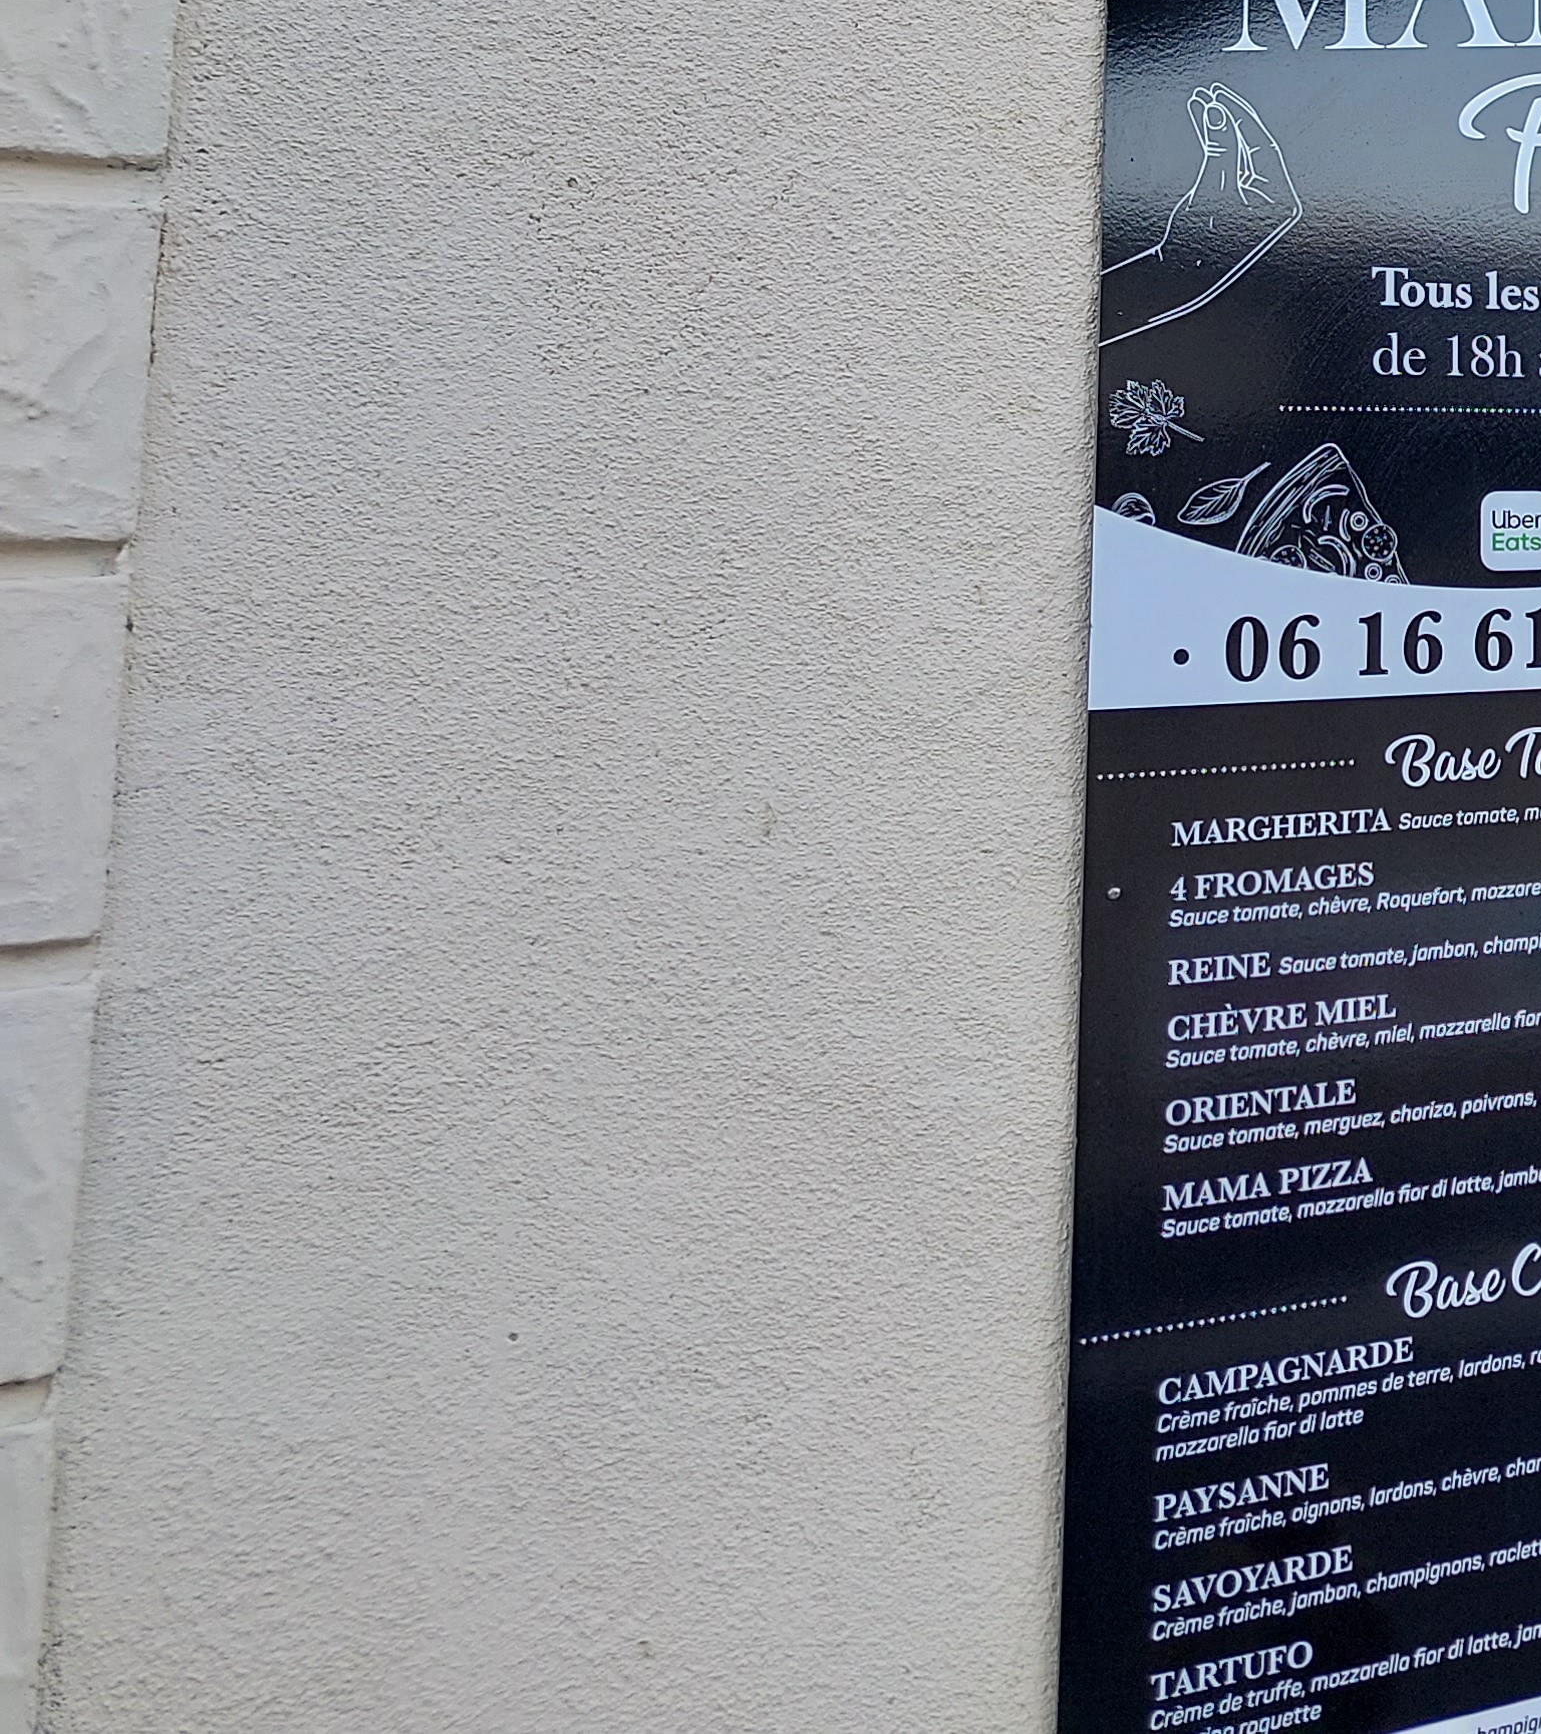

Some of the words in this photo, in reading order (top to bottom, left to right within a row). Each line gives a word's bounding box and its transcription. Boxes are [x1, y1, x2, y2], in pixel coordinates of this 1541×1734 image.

[1371, 266, 1473, 312] Tous
[1485, 270, 1541, 314] les
[1372, 333, 1427, 378] de
[1446, 335, 1522, 379] 18h
[1224, 613, 1322, 682] 06
[1357, 609, 1444, 677] 16
[1385, 733, 1501, 788] Base
[1171, 808, 1392, 847] MARGHERITA
[1398, 813, 1454, 830] Sauce
[1456, 807, 1520, 826] tomate,
[1169, 909, 1230, 928] Sauce
[1233, 902, 1303, 923] tomate,
[1377, 887, 1467, 912] Roquefort,
[1170, 877, 1188, 902] 4
[1194, 862, 1375, 900] FROMAGES
[1168, 952, 1272, 986] REINE
[1278, 956, 1337, 975] Sauce
[1340, 948, 1408, 969] tomate,
[1408, 940, 1479, 967] jambon,
[1165, 1049, 1226, 1069] Sauce
[1230, 1039, 1301, 1062] tomate,
[1305, 1032, 1370, 1053] chèvre,
[1375, 1023, 1415, 1046] miel,
[1419, 1012, 1512, 1040] mozzarella
[1168, 1003, 1308, 1042] CHÈVRE
[1315, 994, 1397, 1027] MIEL
[1163, 1132, 1225, 1154] Sauce
[1228, 1122, 1300, 1146] tomate,
[1304, 1112, 1386, 1136] merguez,
[1390, 1100, 1457, 1125] chorizo,
[1460, 1092, 1538, 1120] poivrons,
[1166, 1079, 1357, 1126] ORIENTALE
[1161, 1216, 1221, 1239] Sauce
[1223, 1206, 1293, 1230] tomate,
[1297, 1187, 1395, 1219] mozzarella
[1398, 1183, 1430, 1204] fior
[1431, 1178, 1448, 1199] di
[1451, 1175, 1495, 1196] latte,
[1162, 1172, 1272, 1212] MAMA
[1279, 1157, 1374, 1195] PIZZA
[1386, 1261, 1507, 1319] Base
[1157, 1409, 1221, 1434] Crème
[1224, 1394, 1294, 1422] fraîche,
[1298, 1380, 1378, 1414] pommes
[1382, 1372, 1405, 1393] de
[1407, 1367, 1454, 1388] terre,
[1458, 1353, 1526, 1379] lardons,
[1159, 1336, 1414, 1405] CAMPAGNARDE
[1156, 1425, 1260, 1463] mozzarella
[1263, 1420, 1297, 1442] fior
[1299, 1413, 1317, 1435] di
[1320, 1409, 1365, 1432] latte
[1154, 1524, 1216, 1551] Crème
[1219, 1509, 1287, 1538] fraîche,
[1291, 1495, 1366, 1525] oignons,
[1370, 1480, 1437, 1508] lardons,
[1441, 1466, 1502, 1492] chèvre,
[1155, 1463, 1330, 1523] PAYSANNE
[1152, 1614, 1216, 1642] Crème
[1218, 1597, 1287, 1628] fraîche,
[1287, 1583, 1362, 1618] jambon,
[1366, 1555, 1486, 1595] champignons,
[1153, 1545, 1353, 1613] SAVOYARDE
[1150, 1702, 1215, 1731] Crème
[1218, 1693, 1244, 1715] de
[1247, 1678, 1306, 1708] truffe,
[1310, 1653, 1411, 1694] mozzarella
[1413, 1647, 1446, 1669] fior
[1447, 1638, 1465, 1660] di
[1467, 1632, 1513, 1656] latte,
[1151, 1641, 1313, 1702] TARTUFO
[1239, 1704, 1323, 1734] roquette
